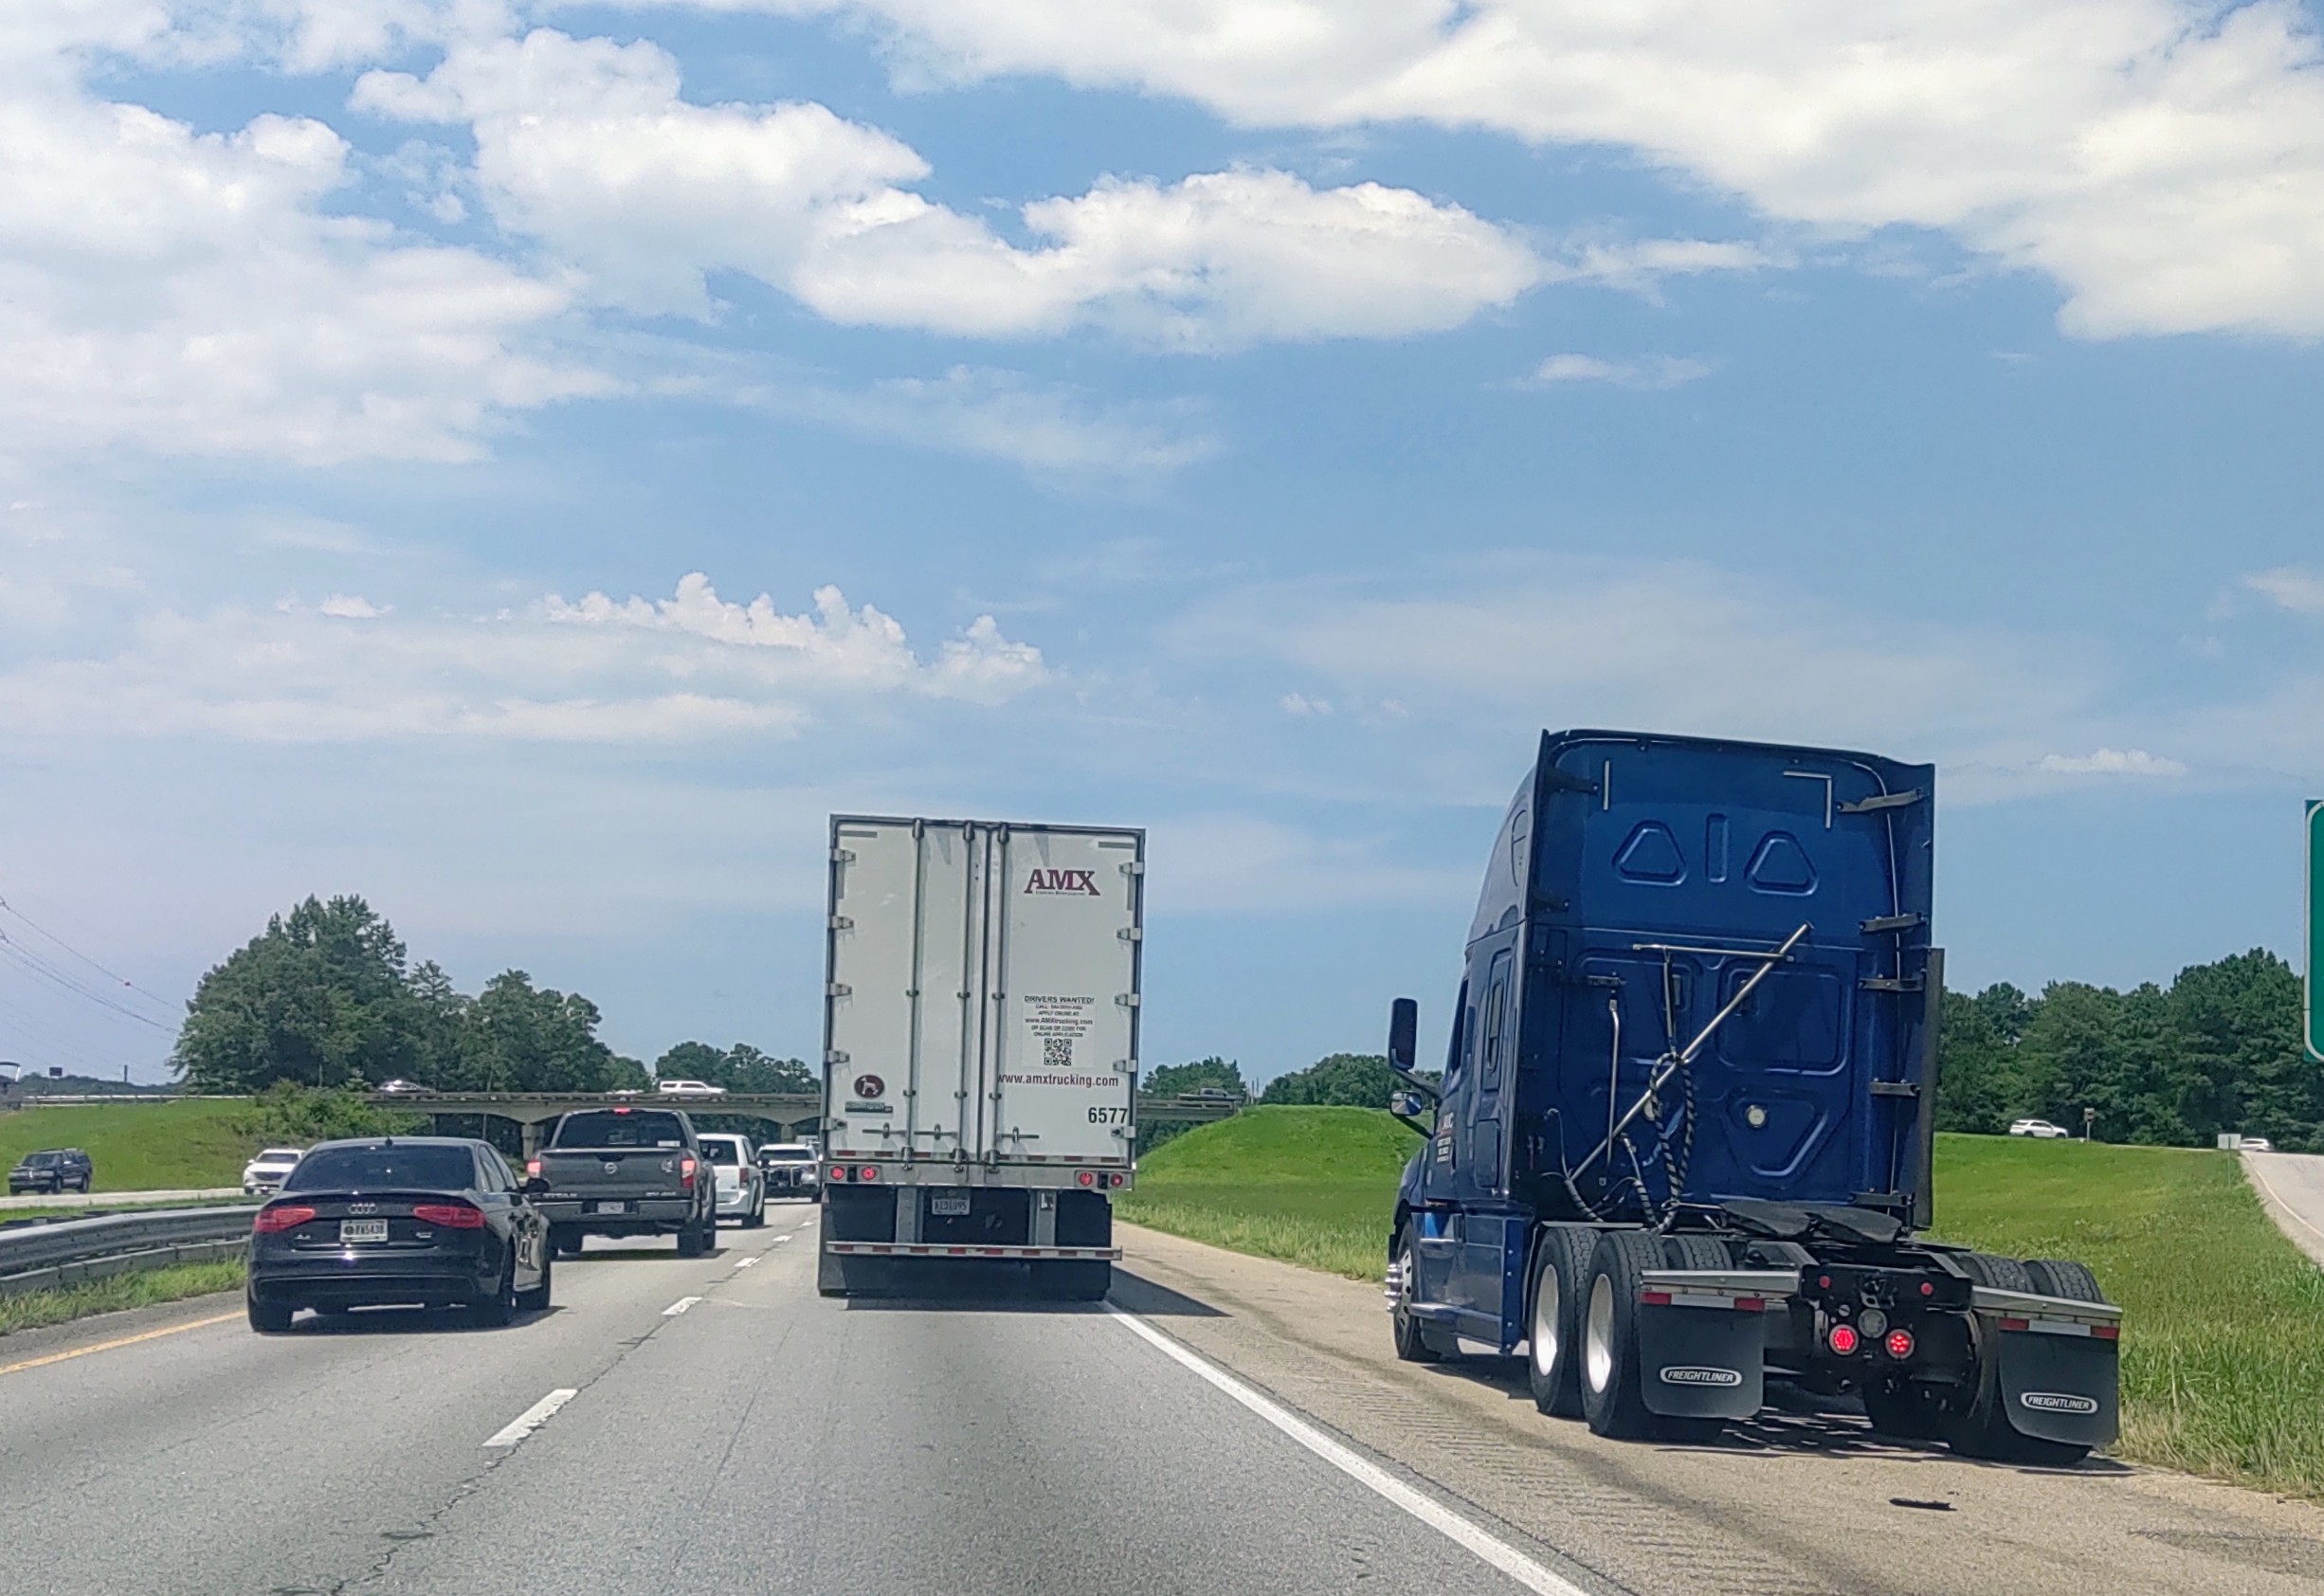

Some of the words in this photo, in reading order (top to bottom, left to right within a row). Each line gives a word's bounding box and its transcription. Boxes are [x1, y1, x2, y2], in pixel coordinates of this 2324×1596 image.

[1024, 869, 1100, 896] AMX
[997, 1074, 1118, 1088] www.amxtrucking.com
[1088, 1107, 1128, 1124] 6577
[1668, 1370, 1734, 1382] FREIGHTLINER
[2028, 1396, 2089, 1409] FREIGHTLINER
